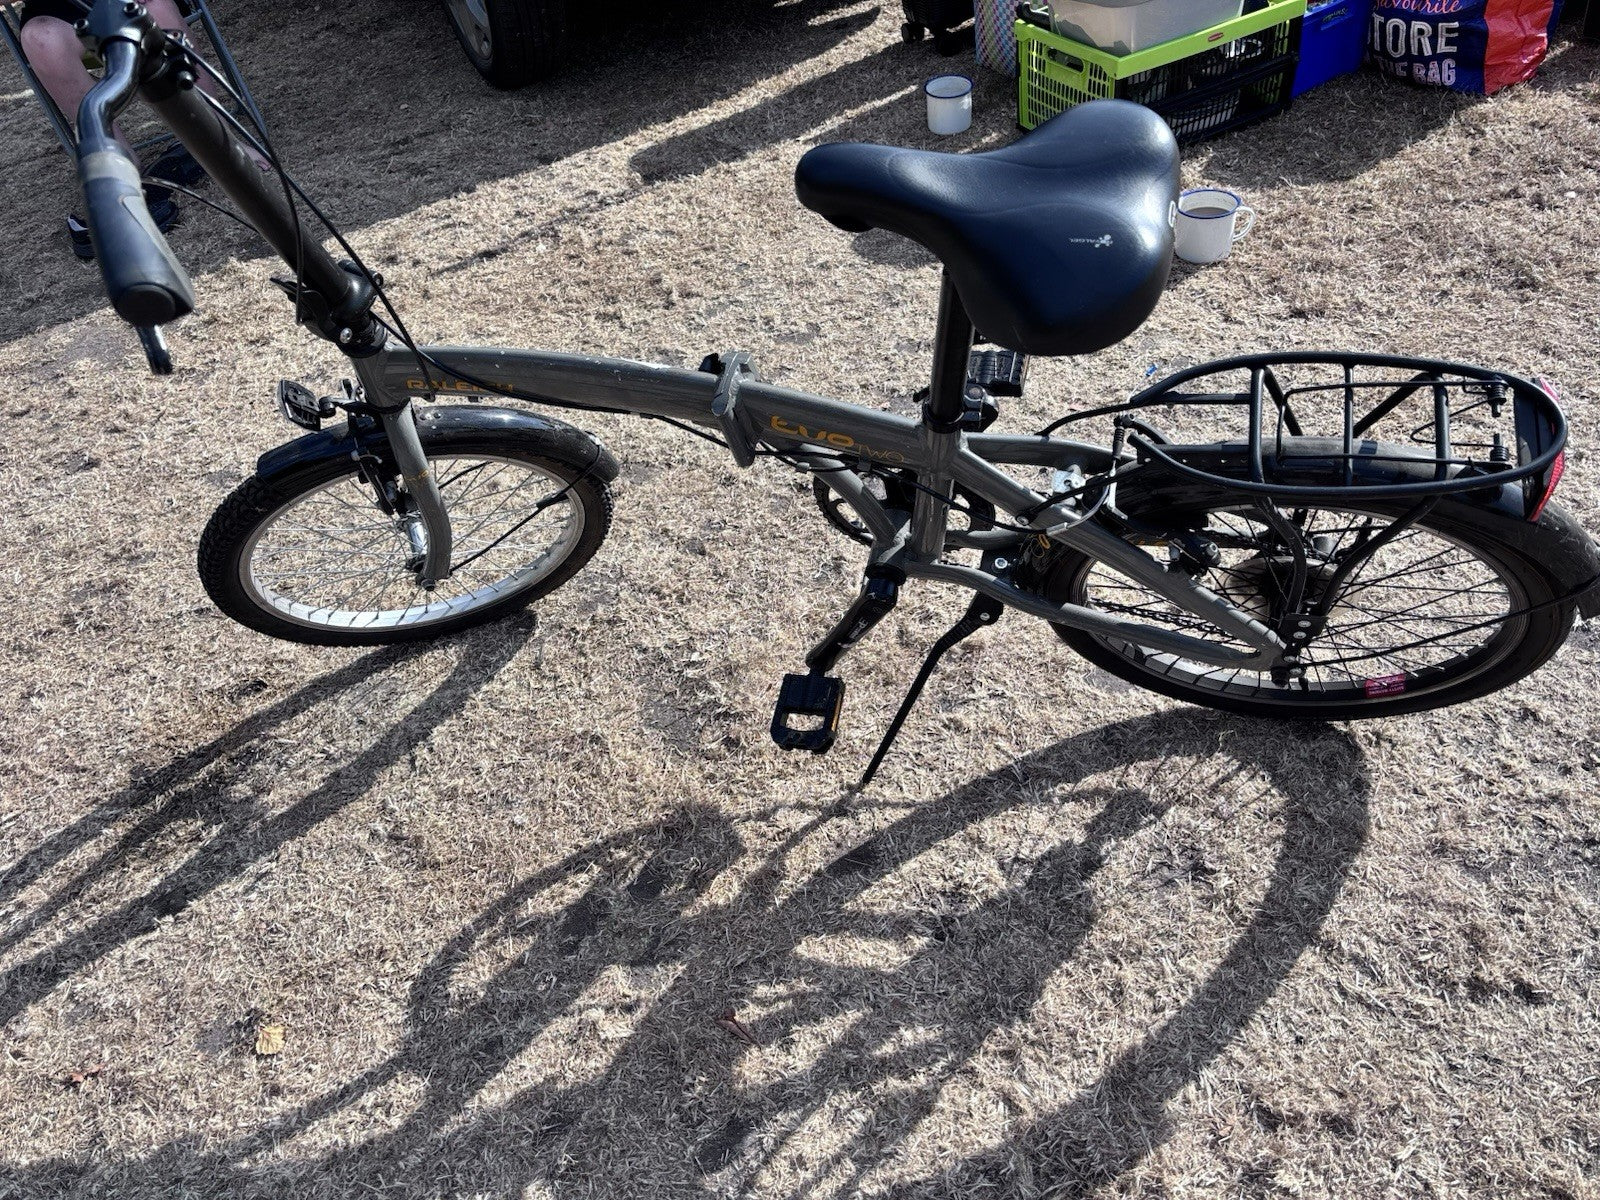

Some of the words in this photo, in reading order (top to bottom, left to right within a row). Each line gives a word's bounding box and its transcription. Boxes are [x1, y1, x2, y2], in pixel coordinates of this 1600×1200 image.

[1367, 12, 1459, 57] TORE
[1413, 58, 1456, 86] BAG
[406, 379, 514, 392] RALEIH
[856, 444, 905, 463] TWO
